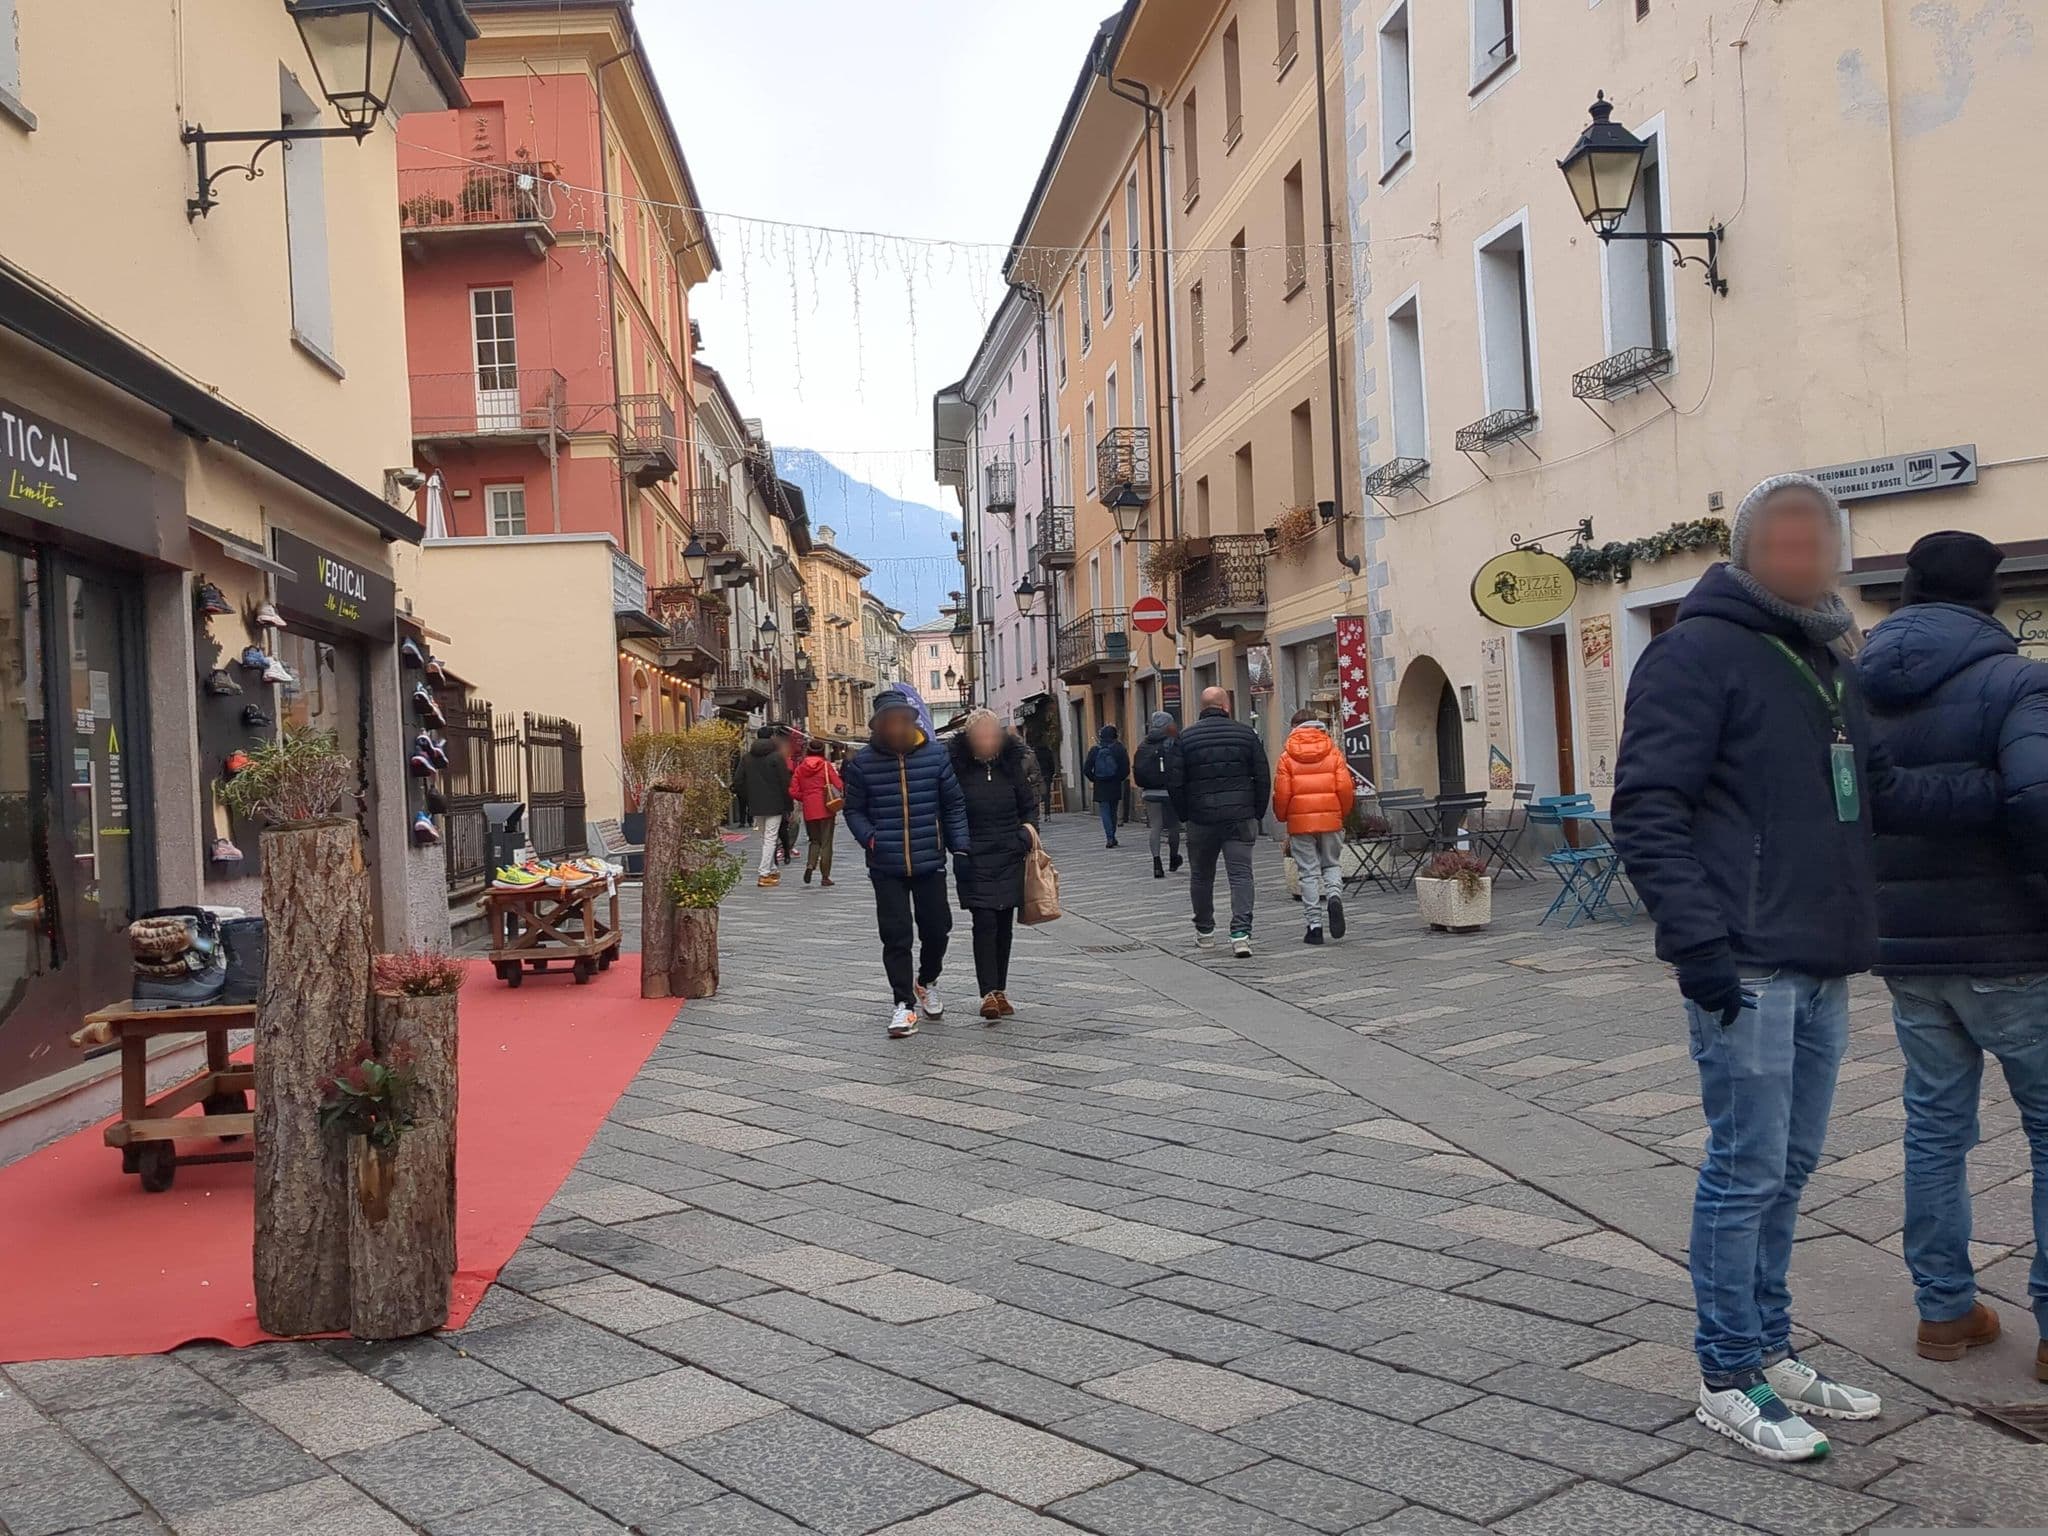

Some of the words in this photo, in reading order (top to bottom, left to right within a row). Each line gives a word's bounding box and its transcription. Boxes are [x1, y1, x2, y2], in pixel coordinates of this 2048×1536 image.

[0, 411, 77, 481] TICAL
[1817, 468, 1857, 481] REGIONALE
[1860, 467, 1869, 476] DI
[1870, 463, 1895, 474] AOSTA
[318, 555, 367, 601] VERTICAL
[1519, 575, 1561, 591] PIZZE
